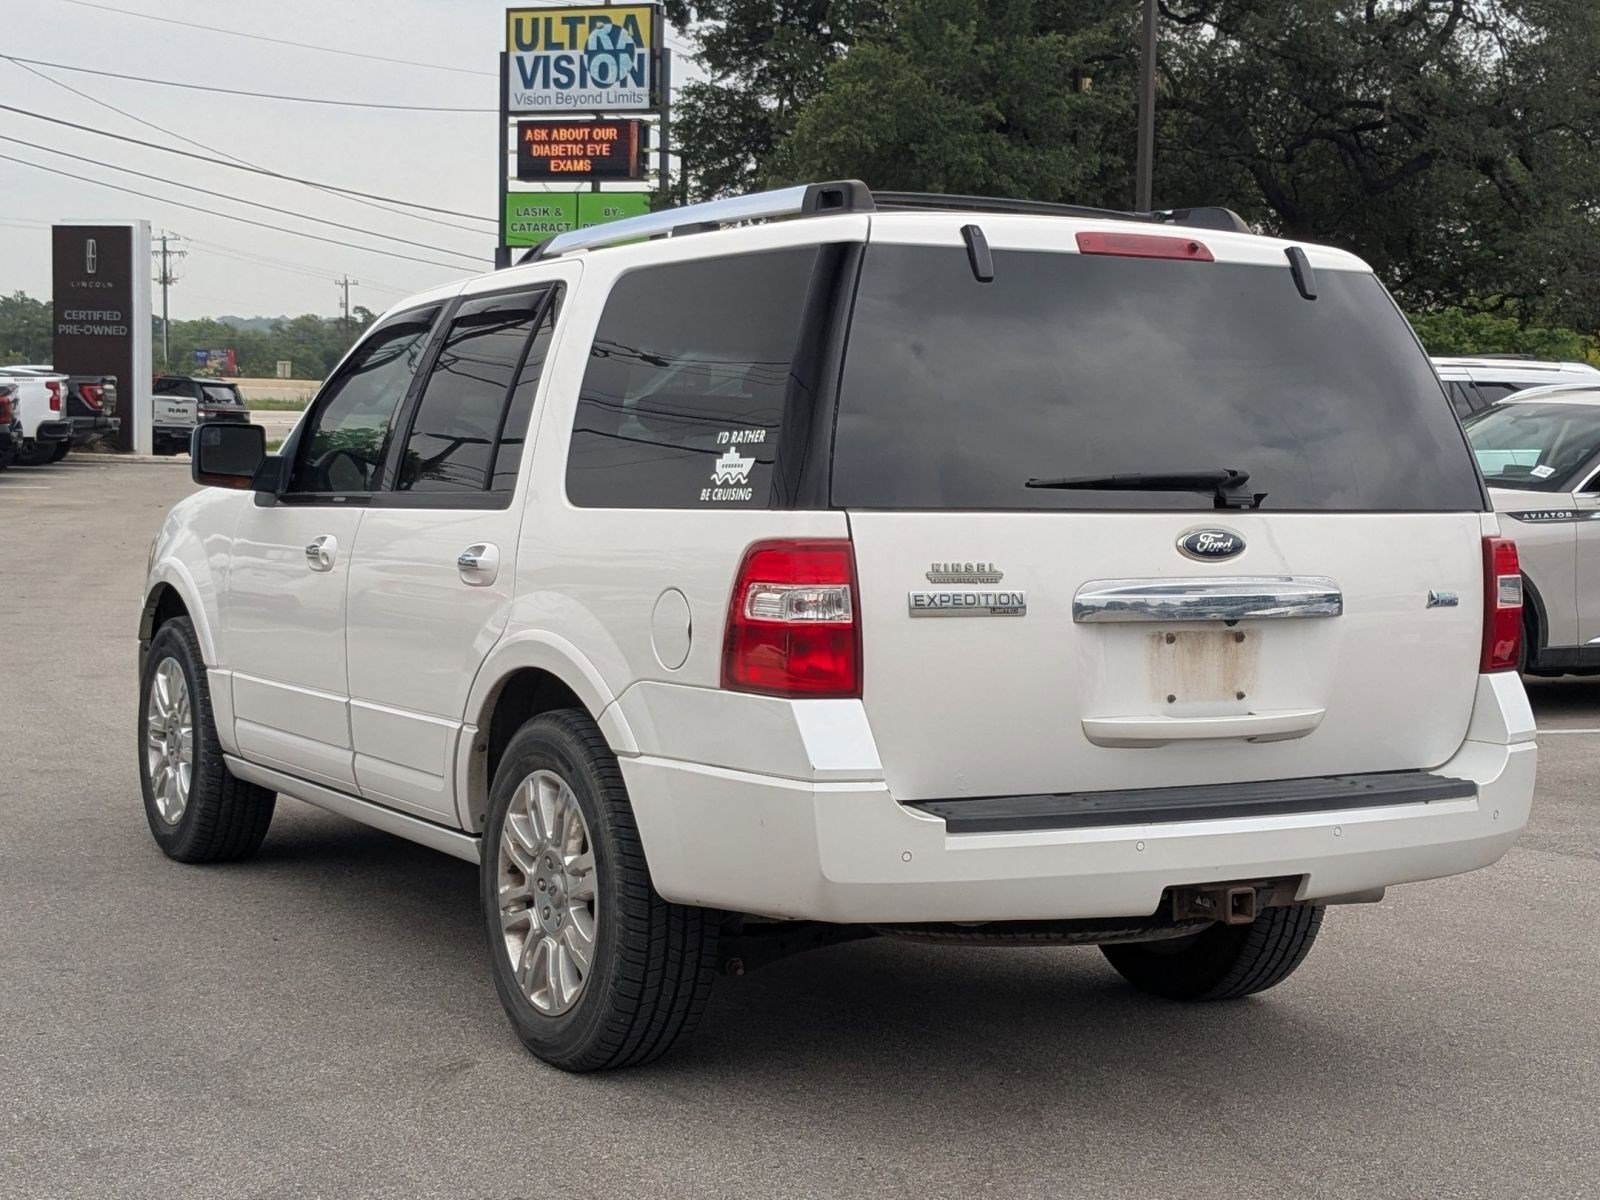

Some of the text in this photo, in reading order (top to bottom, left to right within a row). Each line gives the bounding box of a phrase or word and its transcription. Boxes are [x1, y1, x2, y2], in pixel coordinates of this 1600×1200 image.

[514, 14, 645, 52] ULTRA
[515, 53, 646, 90] VISION
[514, 91, 644, 107] Vision Beyond Limits
[525, 128, 618, 141] ASK ABOUT OUR
[532, 143, 611, 157] DIABETIC EYE
[550, 159, 592, 172] EXAMS
[516, 207, 563, 217] LASIK &
[510, 223, 571, 232] CATARACT
[64, 310, 122, 321] CERTIFIED
[58, 324, 128, 336] PRE-OWNED
[168, 407, 189, 415] RAM
[716, 430, 766, 444] I'D RATHER
[700, 487, 753, 501] BE CRUISING
[1196, 532, 1234, 553] Ford
[931, 562, 999, 573] KINSEL
[913, 593, 1024, 607] EXPEDITION
